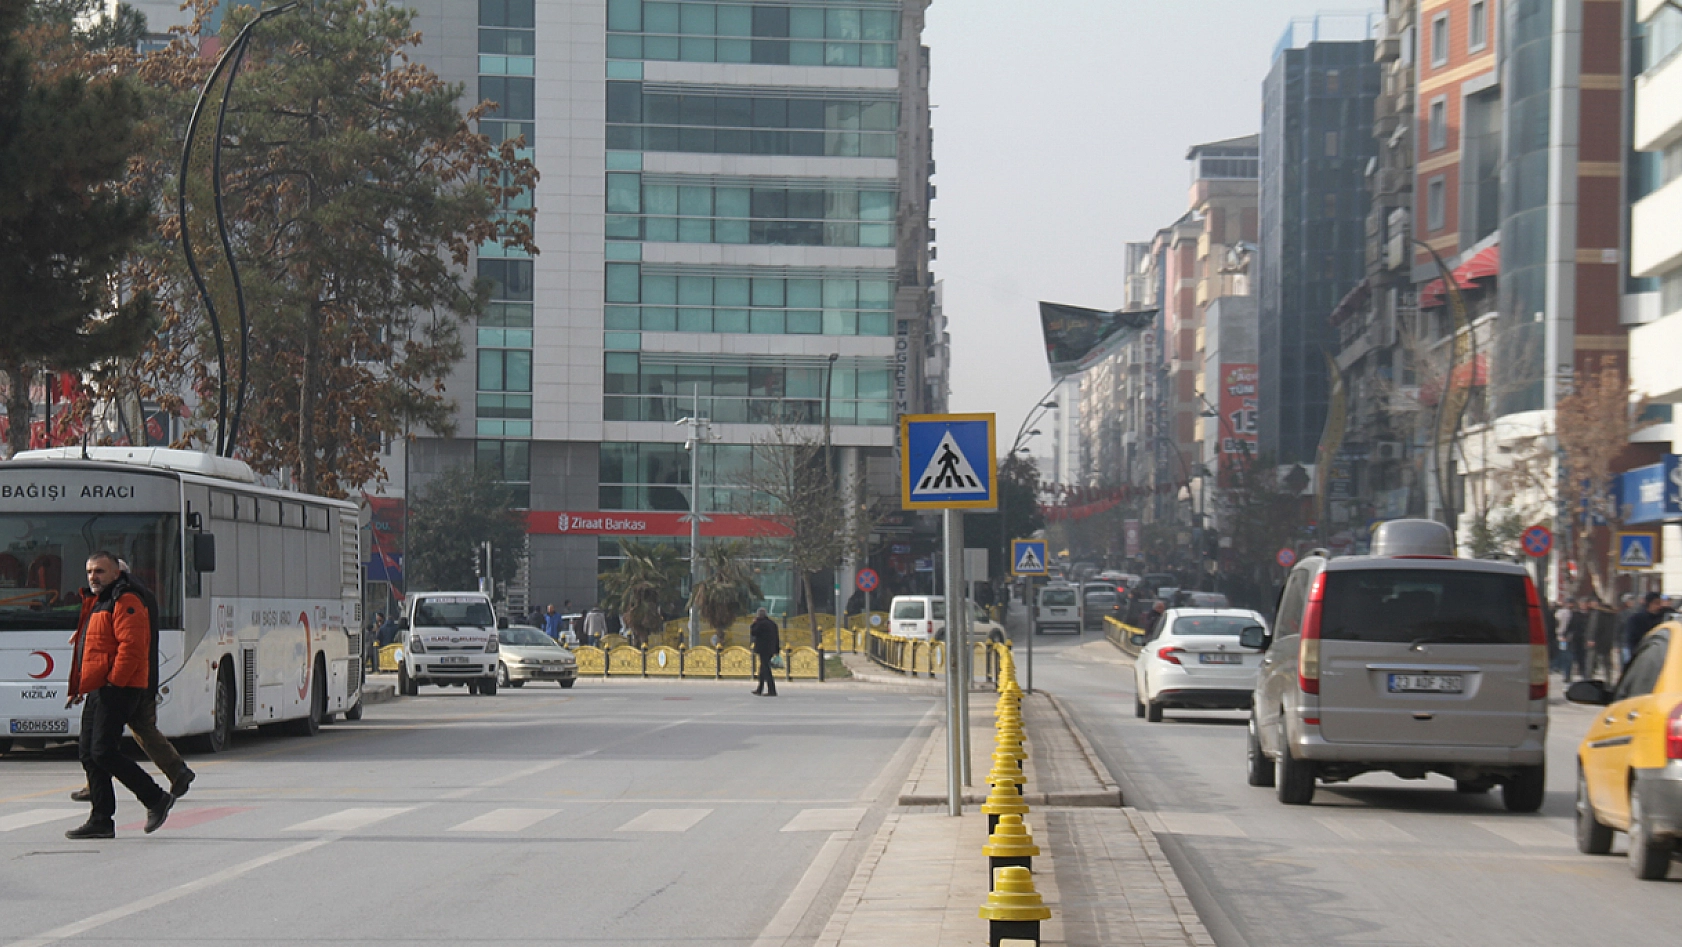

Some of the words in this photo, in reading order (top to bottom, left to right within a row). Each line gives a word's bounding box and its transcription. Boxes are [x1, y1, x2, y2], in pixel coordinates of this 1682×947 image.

[2, 483, 66, 501] BAĞIŞI
[80, 485, 135, 498] ARACI
[571, 516, 603, 530] Ziraat
[605, 517, 646, 531] Bankası
[21, 690, 58, 699] KIZILAY
